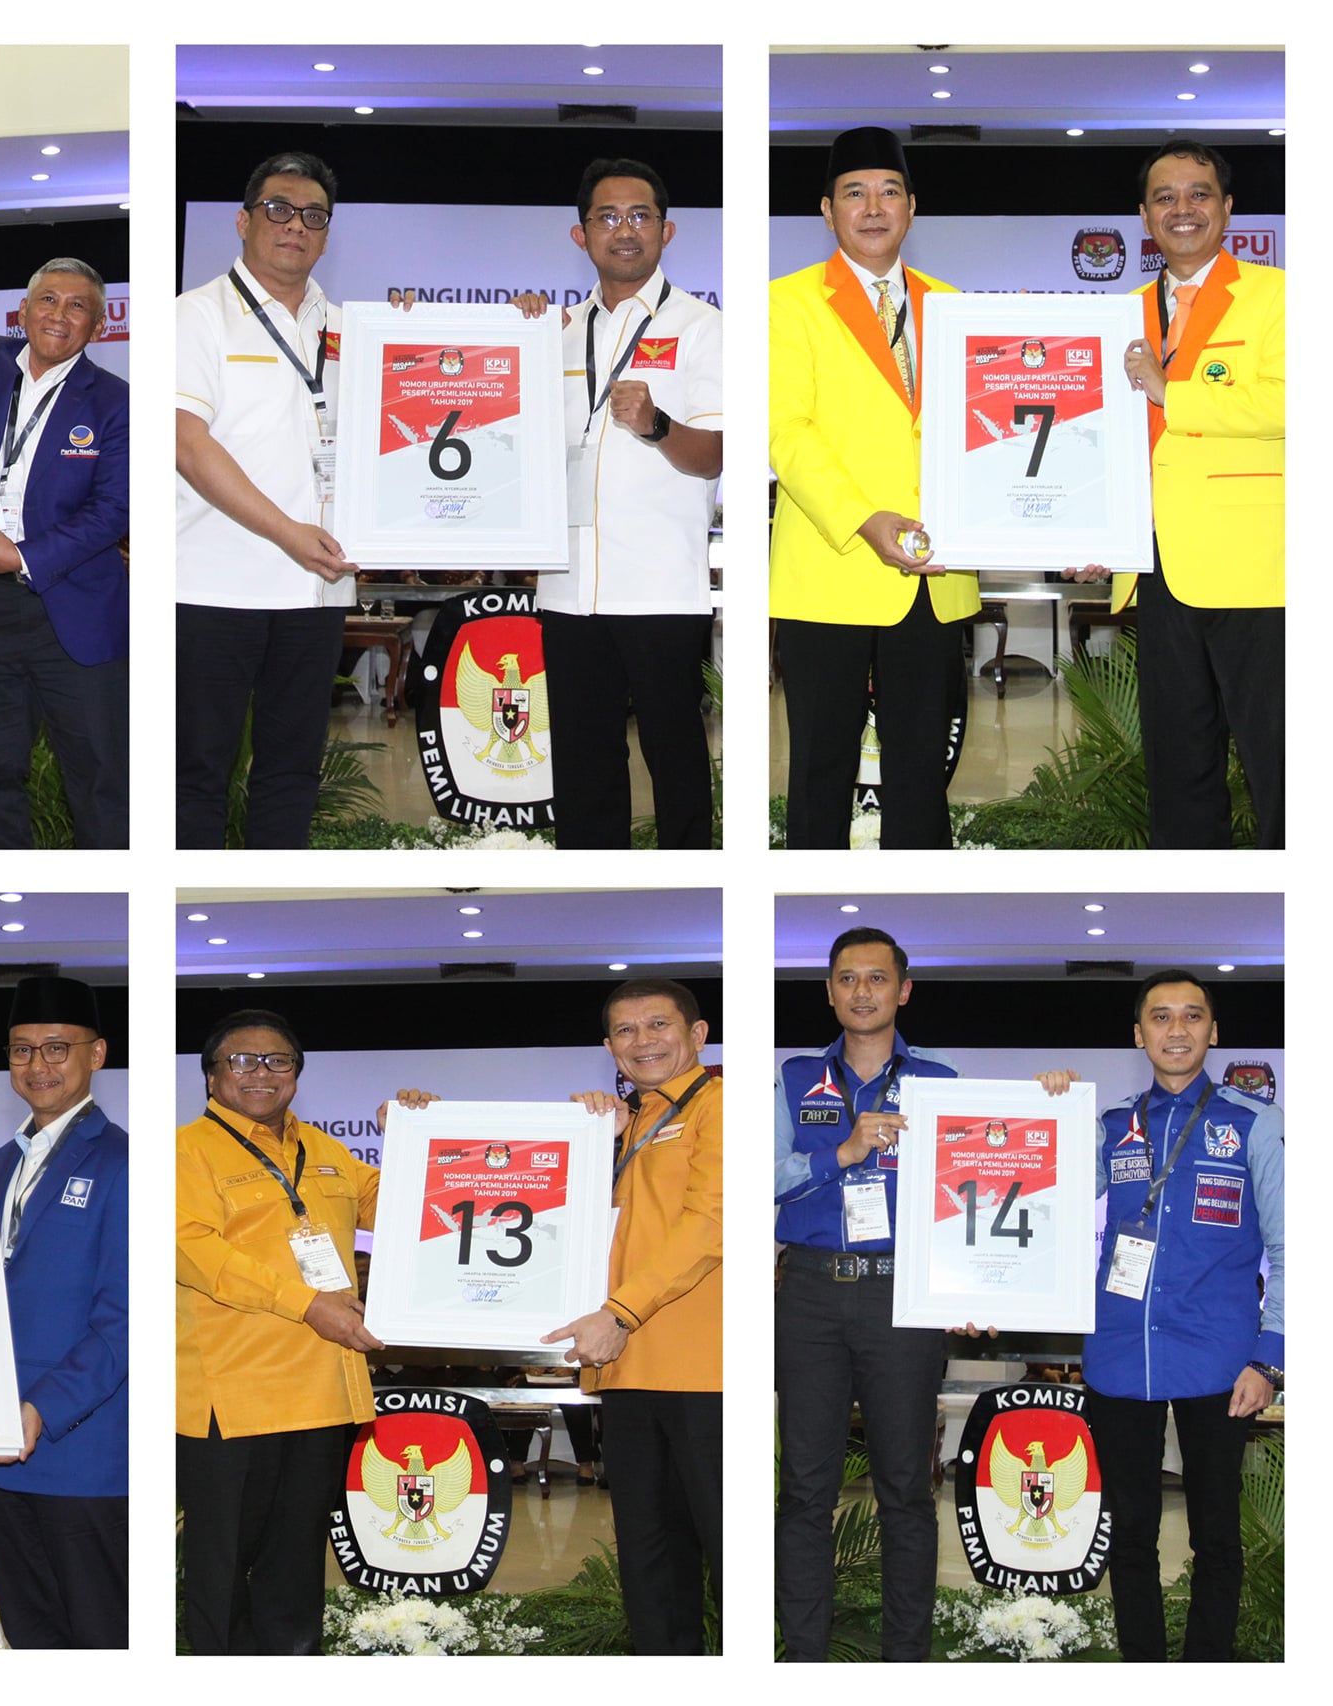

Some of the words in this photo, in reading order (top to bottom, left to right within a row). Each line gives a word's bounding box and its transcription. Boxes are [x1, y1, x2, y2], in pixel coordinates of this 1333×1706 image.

[486, 359, 508, 367] KPU
[1068, 350, 1090, 358] KPU
[429, 411, 471, 480] 6
[1014, 405, 1055, 477] 7
[463, 593, 537, 617] KOMI
[420, 730, 533, 826] PEMILIHAN
[806, 1111, 829, 1121] AHY
[62, 1195, 86, 1207] PAN
[452, 1201, 533, 1267] 13
[958, 1180, 1033, 1247] 14
[995, 1388, 1085, 1411] KOMISI
[330, 1510, 442, 1593] PEMILIHAN
[453, 1512, 505, 1590] UMUM
[958, 1506, 1058, 1592] PEMILIHAN
[1069, 1511, 1112, 1589] UMUM
